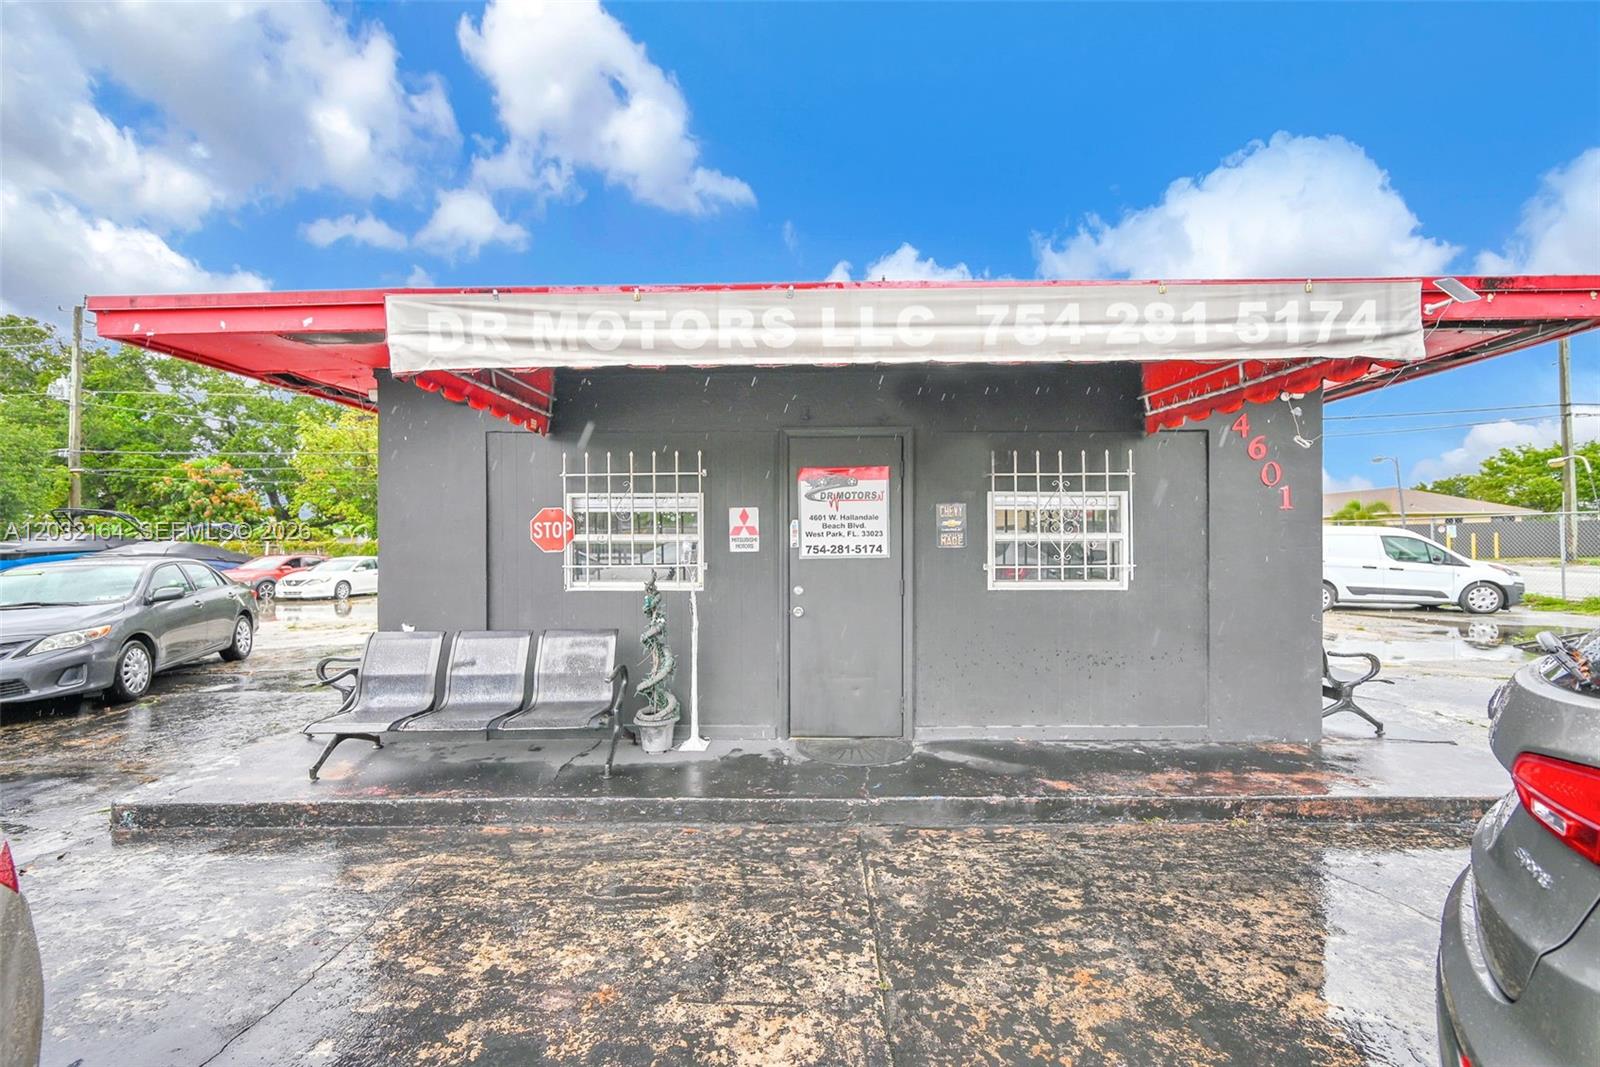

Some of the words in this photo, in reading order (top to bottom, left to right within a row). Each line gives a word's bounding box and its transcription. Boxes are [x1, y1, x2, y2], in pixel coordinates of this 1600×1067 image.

[427, 311, 512, 353] DR
[533, 306, 798, 353] MOTORS
[821, 305, 936, 349] LLC
[976, 299, 1382, 347] 754-281-5174
[1231, 413, 1295, 511] 4601
[820, 491, 834, 500] DR
[836, 490, 878, 500] MOTORS
[533, 521, 573, 539] STOP
[861, 530, 884, 538] 33023
[805, 544, 884, 554] 754-281-5174
